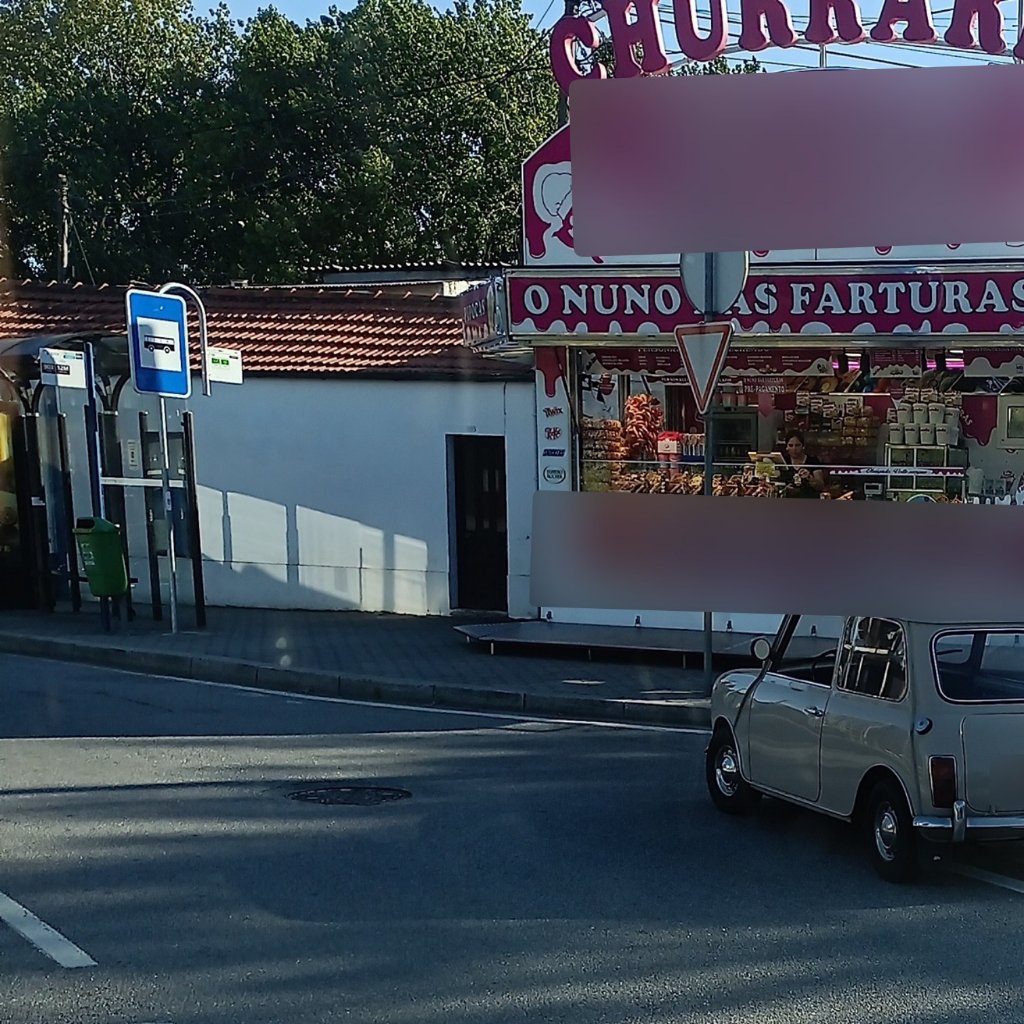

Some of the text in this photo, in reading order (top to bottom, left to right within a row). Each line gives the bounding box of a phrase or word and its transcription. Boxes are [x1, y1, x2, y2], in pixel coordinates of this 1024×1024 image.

[524, 284, 550, 315] O
[560, 283, 681, 315] NUNO
[694, 282, 778, 315] AS
